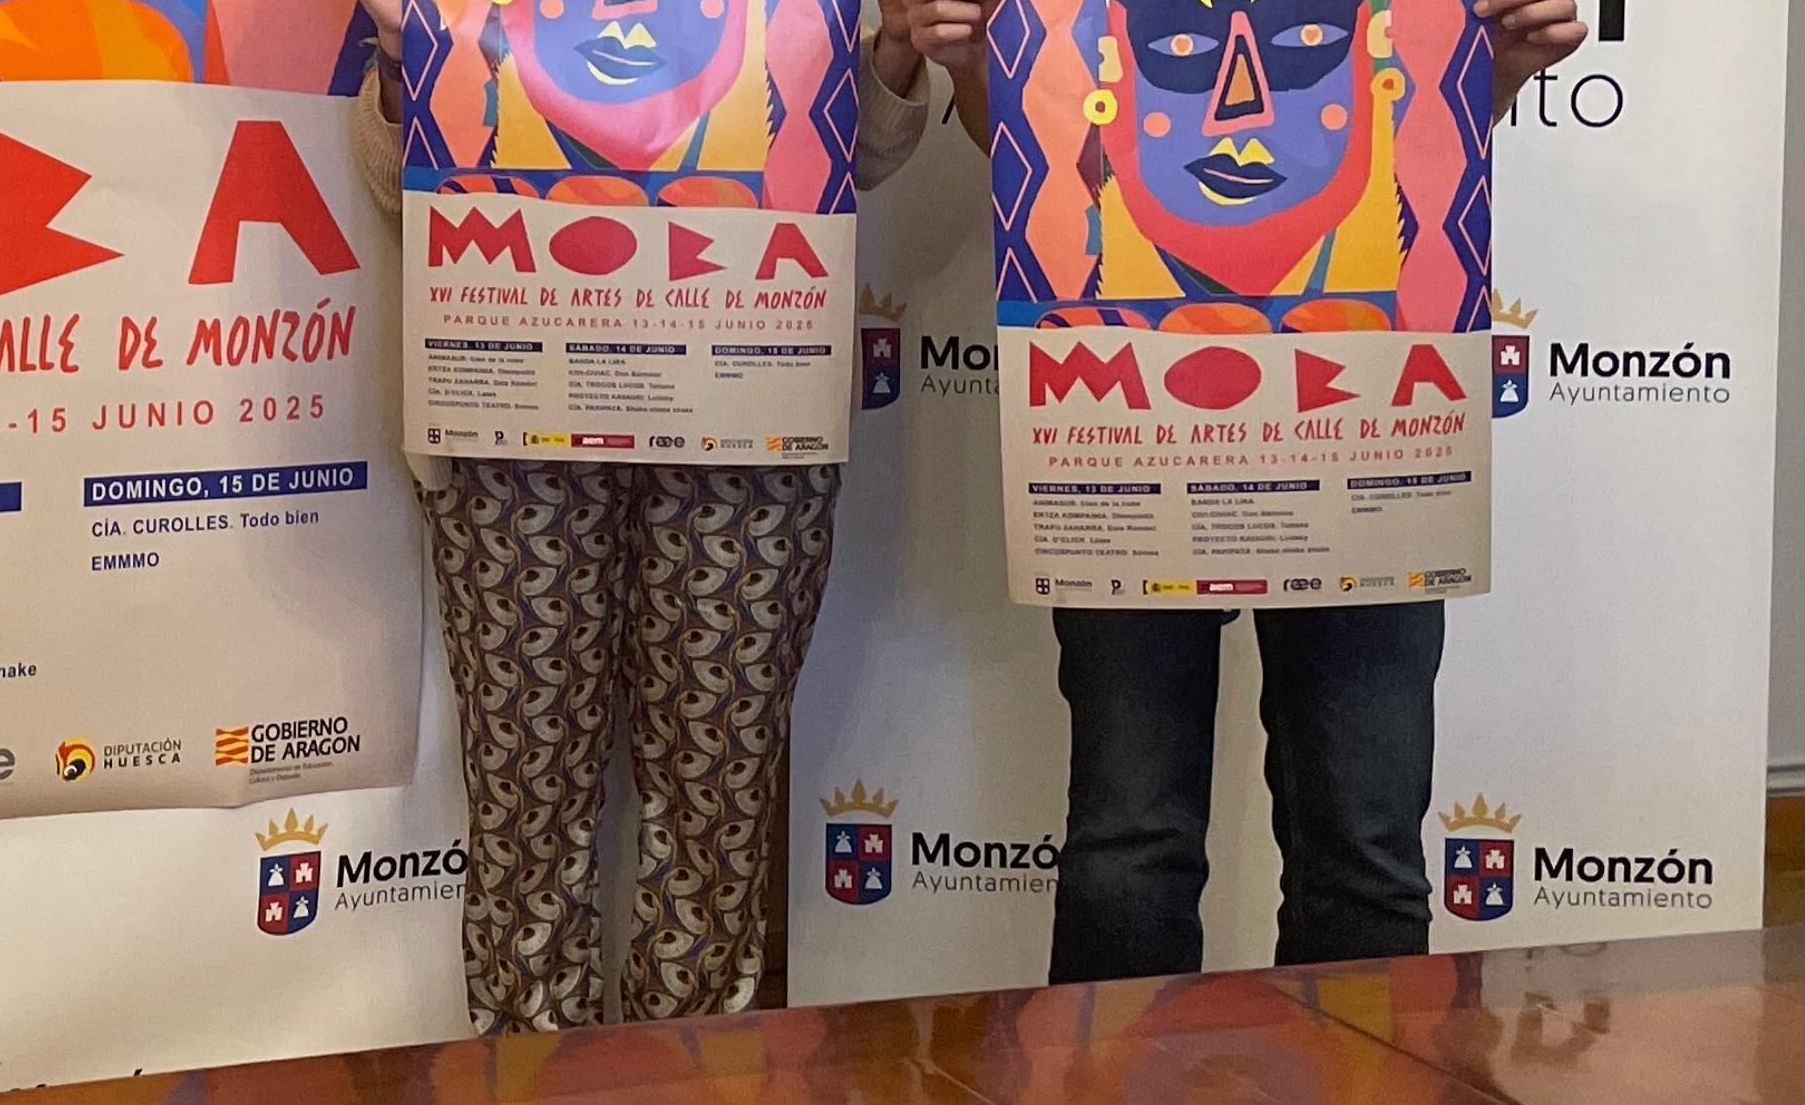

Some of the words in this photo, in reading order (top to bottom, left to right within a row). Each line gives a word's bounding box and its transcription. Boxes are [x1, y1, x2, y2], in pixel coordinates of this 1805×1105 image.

[430, 287, 452, 302] XVI
[461, 286, 528, 305] FESTIVAL
[540, 287, 558, 307] DE
[571, 288, 622, 308] ARTES
[636, 289, 655, 308] DE
[665, 287, 710, 309] CALLE
[725, 290, 745, 309] DE
[754, 286, 827, 310] MONZÓN
[118, 316, 163, 370] DE
[186, 298, 356, 367] MONZÓN
[1550, 343, 1730, 379] Monzón
[1550, 380, 1731, 407] Ayuntamiento
[92, 400, 214, 430] JUNIO
[239, 395, 323, 422] 2025
[1033, 427, 1058, 445] XVI
[1067, 425, 1143, 445] FESTIVAL
[1156, 424, 1177, 445] DE
[1191, 422, 1247, 444] ARTES
[1263, 422, 1284, 442] DE
[1294, 417, 1343, 440] CALLE
[1360, 418, 1381, 439] DE
[1391, 410, 1466, 437] MONZÓN
[93, 477, 208, 501] DOMINGO,
[220, 475, 242, 494] 15
[252, 472, 280, 492] DE
[289, 468, 353, 489] JUNIO
[92, 518, 126, 537] CÍA.
[133, 515, 233, 535] CUROLLES.
[240, 512, 279, 528] Todo
[286, 510, 319, 525] bien
[92, 552, 159, 571] EMMMO
[251, 716, 348, 743] GOBIERNO
[103, 738, 182, 757] DIPUTACIÓN
[251, 744, 276, 763] DE
[282, 735, 361, 760] ARAGON
[103, 753, 182, 770] HUESCA
[336, 839, 469, 888] Monzó
[911, 834, 1060, 870] Monzó
[1534, 847, 1713, 885] Monzón
[911, 871, 1059, 894] Ayuntamien
[1533, 885, 1712, 910] Ayuntamiento
